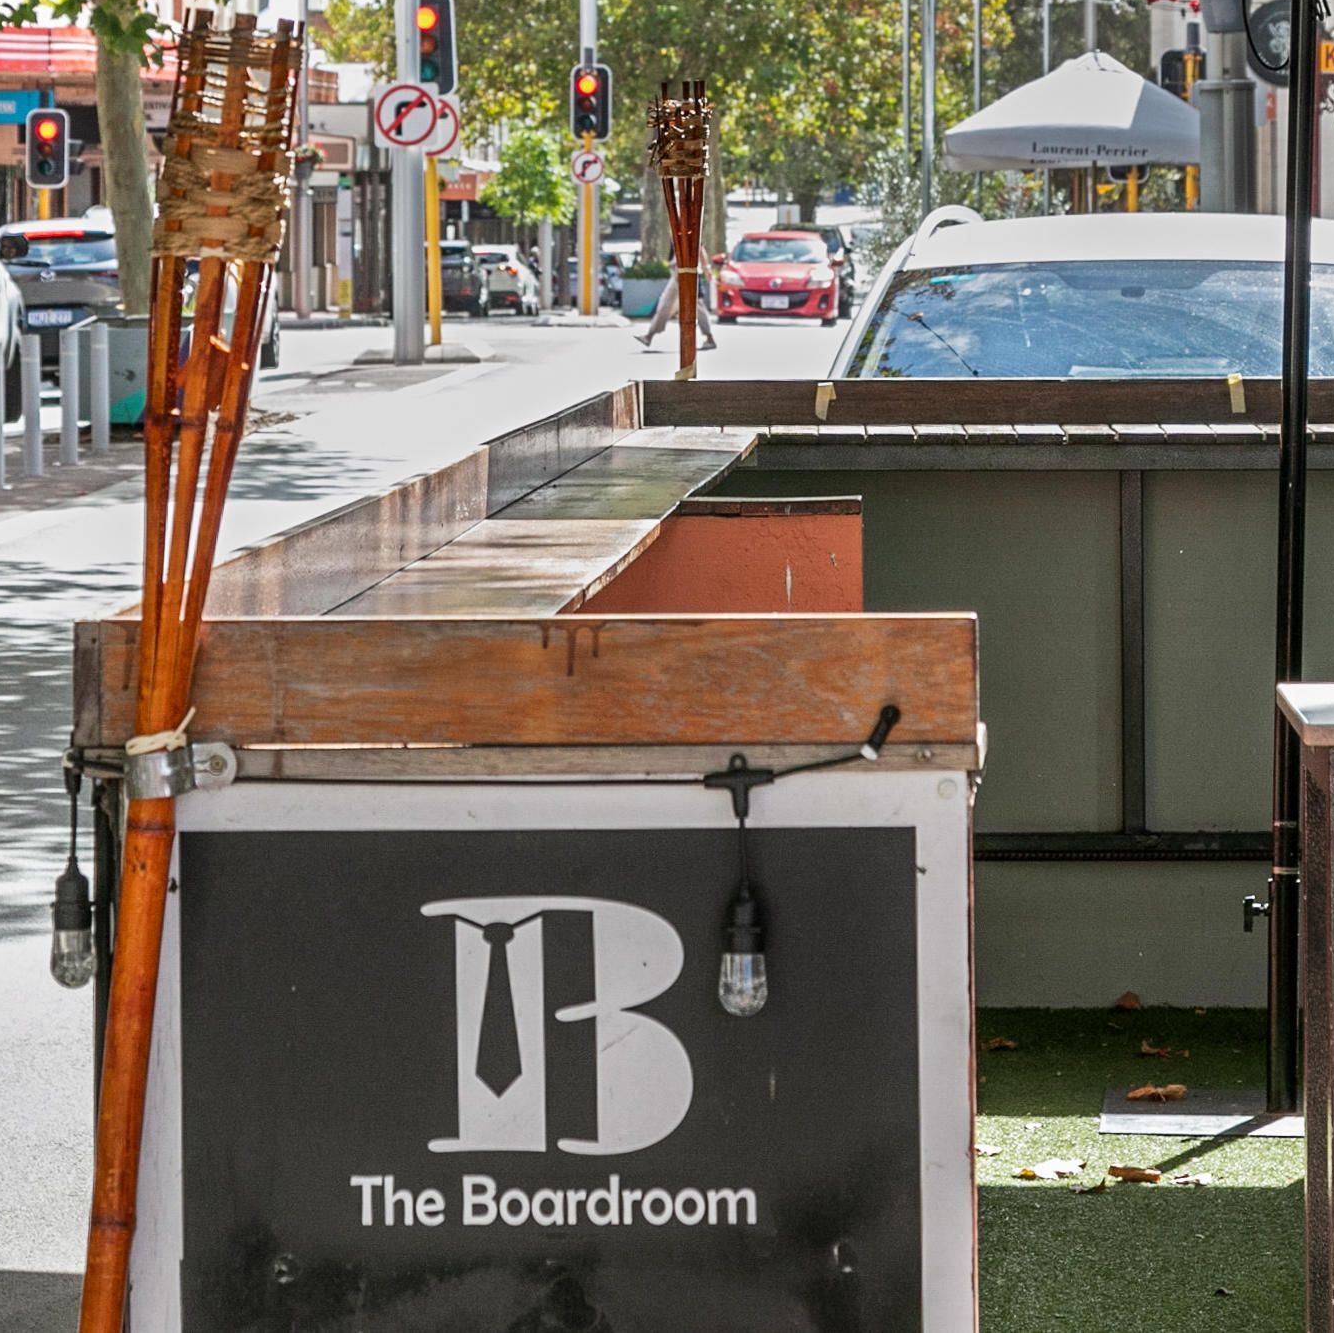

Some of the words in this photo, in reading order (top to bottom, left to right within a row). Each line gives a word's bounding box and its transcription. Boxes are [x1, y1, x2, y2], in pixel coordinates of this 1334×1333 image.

[1032, 141, 1149, 158] Laurent-Perrier
[350, 1175, 445, 1226] The
[462, 1174, 757, 1226] Boardroom
